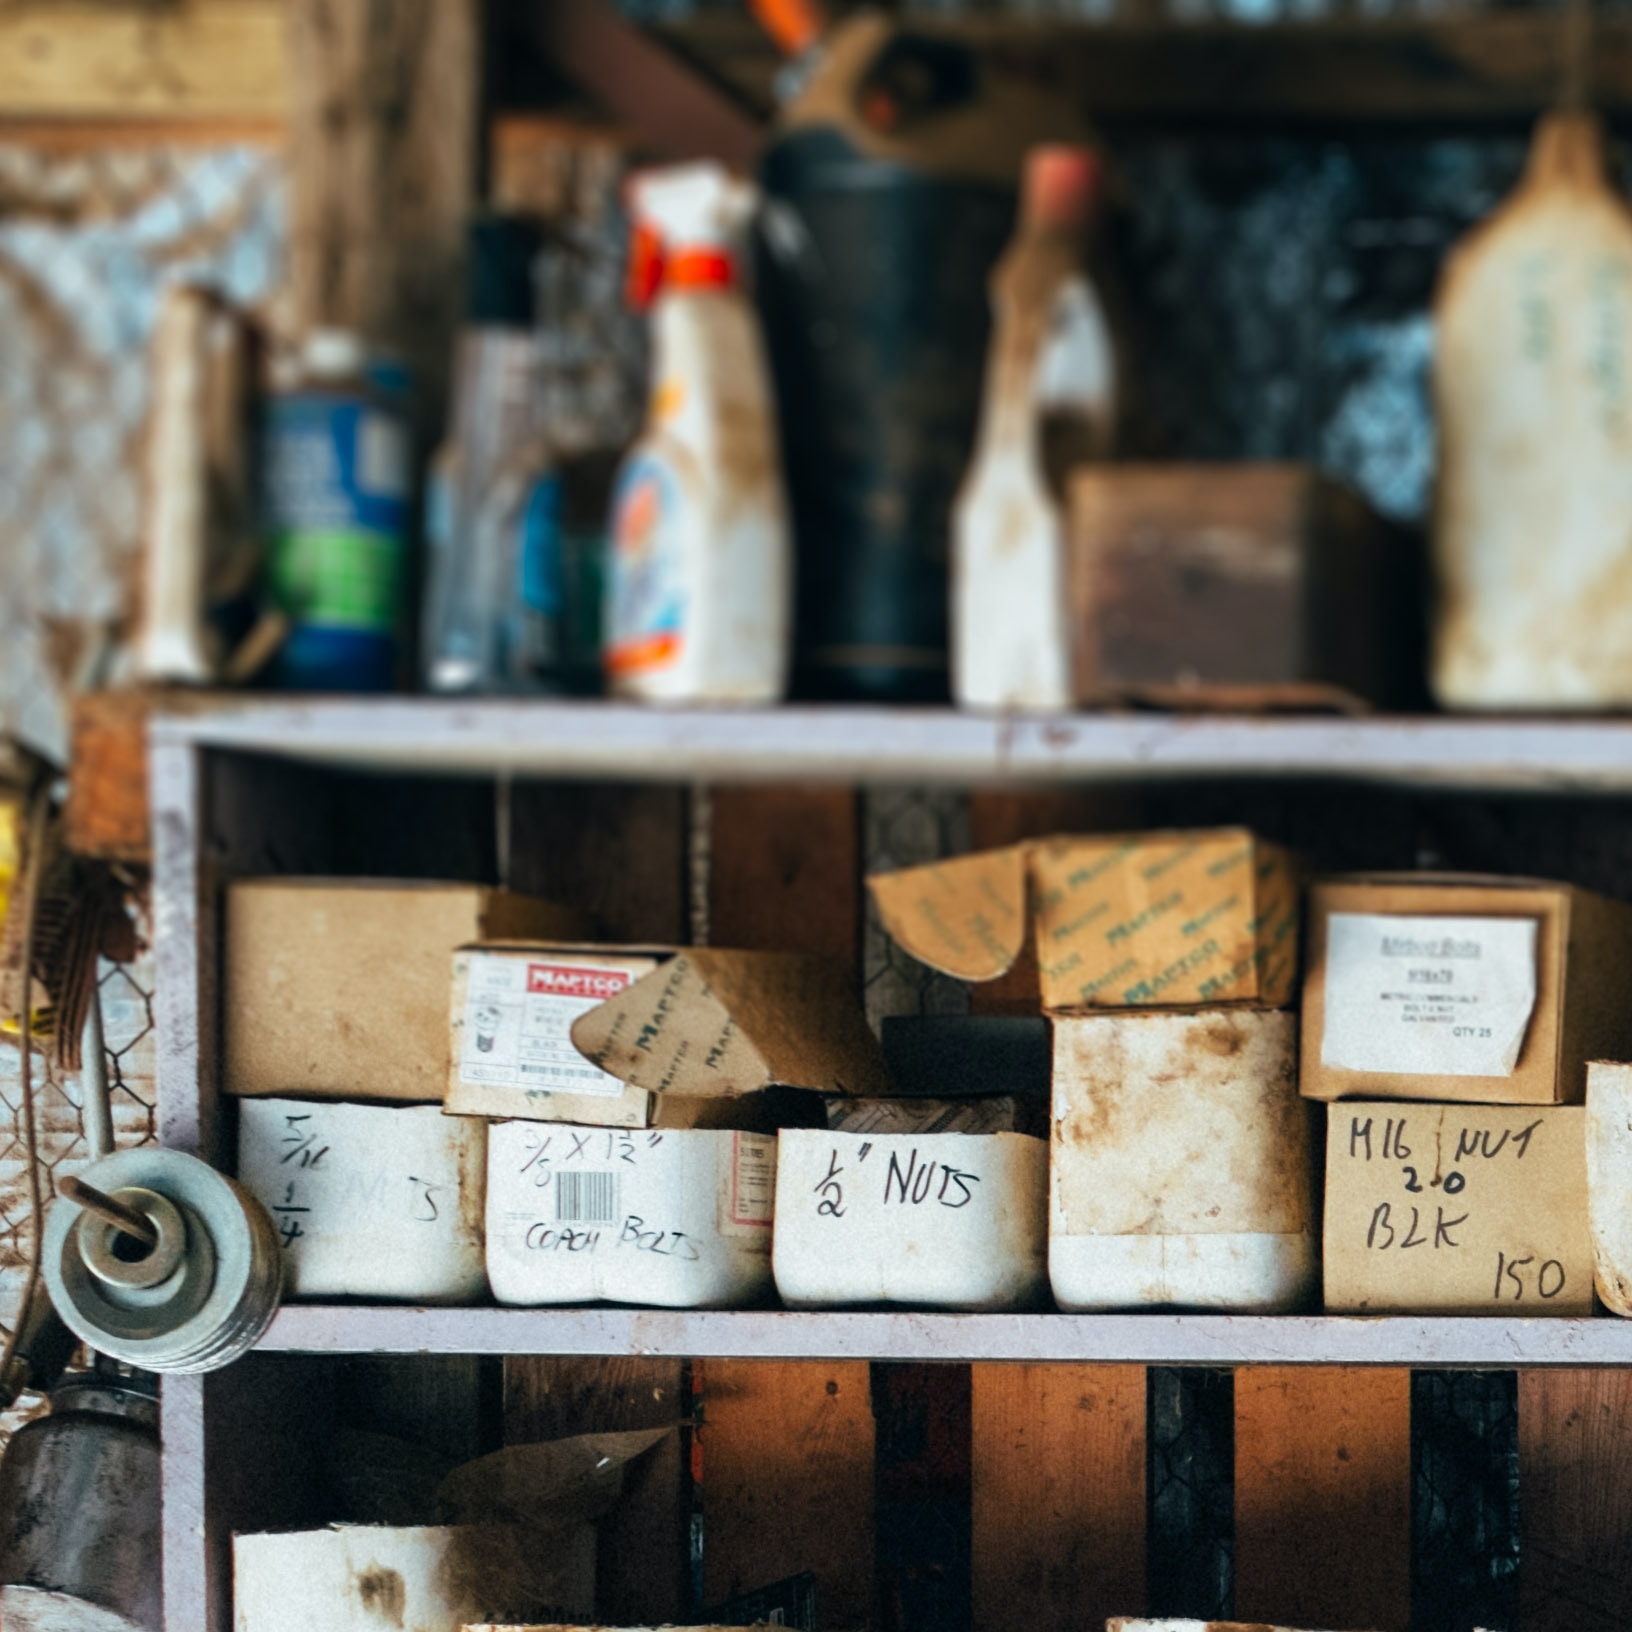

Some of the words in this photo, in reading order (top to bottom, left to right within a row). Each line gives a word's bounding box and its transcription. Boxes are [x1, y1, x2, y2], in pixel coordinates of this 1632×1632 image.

[1452, 1026, 1476, 1038] QTY
[1478, 1026, 1492, 1038] 25
[1349, 1118, 1412, 1162] M16
[1454, 1119, 1544, 1161] NUT
[882, 1147, 982, 1210] NUTS
[525, 1221, 601, 1255] COACH
[1366, 1203, 1470, 1250] BLK
[1492, 1255, 1567, 1302] 150
